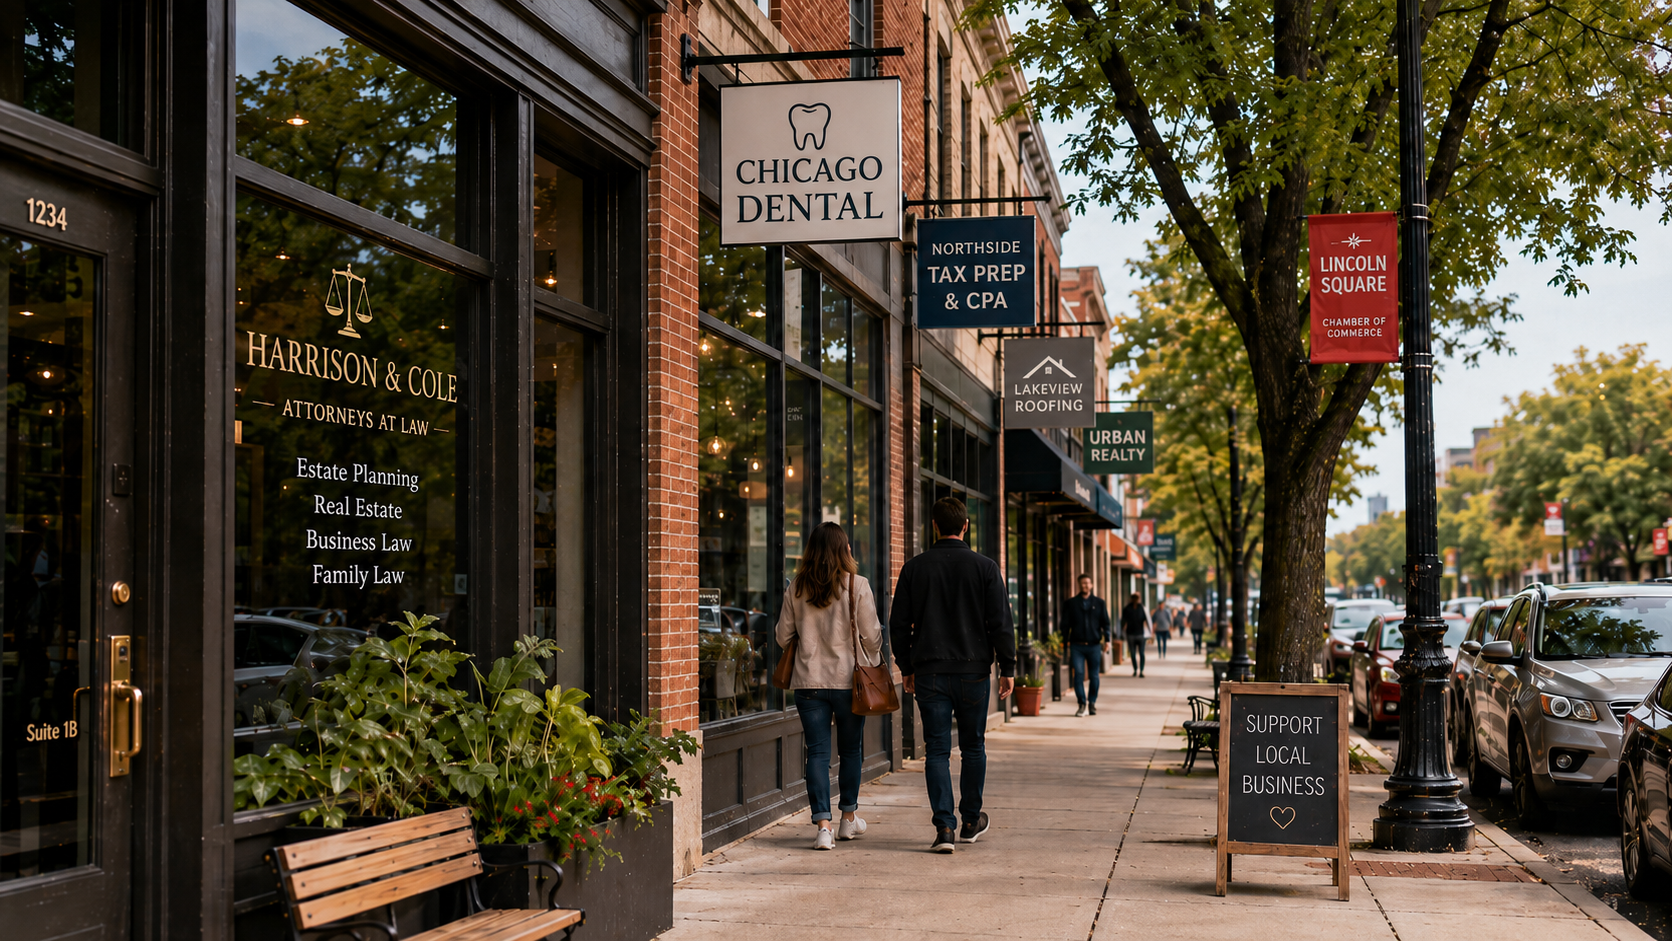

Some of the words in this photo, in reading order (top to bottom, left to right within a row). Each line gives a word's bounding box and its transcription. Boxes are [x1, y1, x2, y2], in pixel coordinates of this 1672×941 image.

[736, 155, 883, 184] CHICAGO
[26, 197, 68, 231] 1234
[737, 191, 884, 223] DENTAL
[932, 241, 1020, 255] NORTHSIDE
[1320, 255, 1386, 272] LINCOLN
[927, 265, 967, 284] TAX
[974, 264, 1026, 283] PREP
[1321, 276, 1386, 295] SQUARE
[944, 292, 959, 310] &
[966, 292, 1008, 310] CPA
[1322, 317, 1370, 327] CHAMBER
[1373, 316, 1386, 326] OF
[1327, 328, 1382, 338] COMMERCE
[246, 331, 378, 388] HARRISON
[386, 361, 402, 392] &
[407, 365, 458, 403] COLE
[1015, 383, 1083, 395] LAKEVIEW
[1015, 399, 1083, 412] ROOFING
[282, 398, 374, 429] ATTORNEYS
[378, 408, 397, 432] AT
[401, 413, 429, 437] LAW
[1090, 430, 1146, 444] URBAN
[1091, 448, 1146, 461] REALTY
[296, 457, 348, 482] Estate
[352, 463, 419, 492] Planning
[314, 495, 350, 516] Real
[355, 498, 403, 519] Estate
[306, 529, 376, 551] Business
[382, 533, 412, 552] Law
[313, 564, 369, 589] Family
[373, 565, 405, 584] Law
[26, 722, 60, 742] Suite
[63, 720, 78, 738] 1B
[1246, 714, 1322, 734] SUPPORT
[1256, 745, 1311, 765] LOCAL
[1243, 775, 1325, 796] BUSINESS
